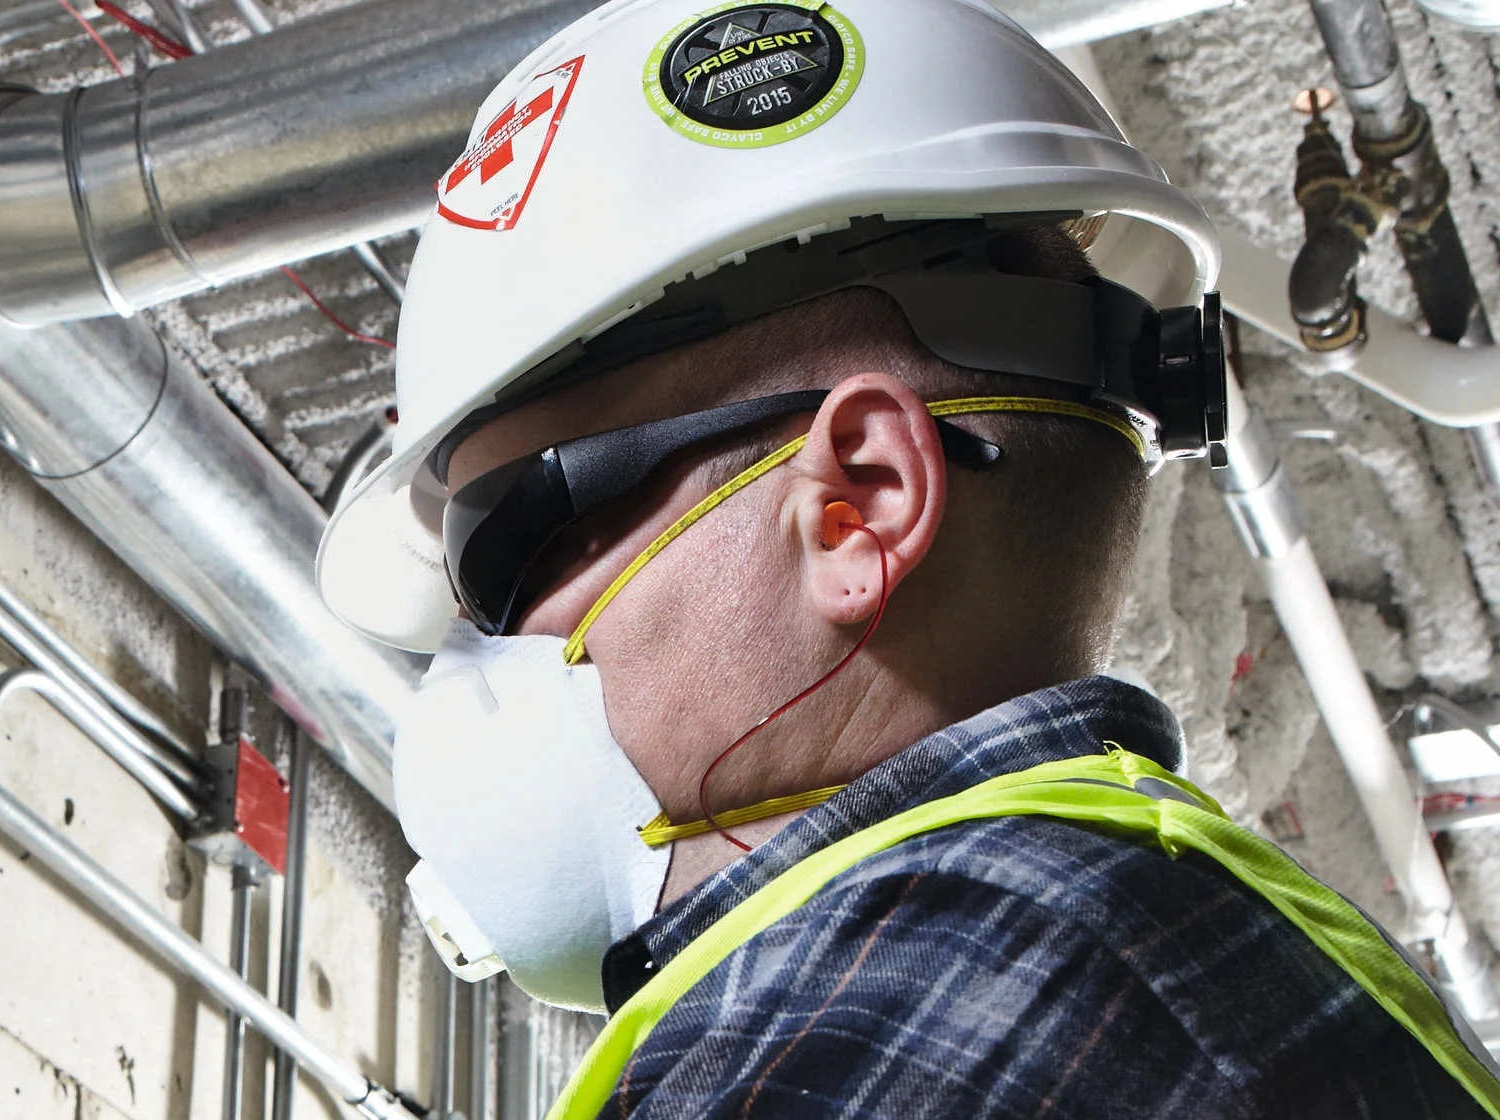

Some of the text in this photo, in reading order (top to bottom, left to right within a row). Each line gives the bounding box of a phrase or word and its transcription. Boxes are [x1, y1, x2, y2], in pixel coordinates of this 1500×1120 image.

[827, 15, 854, 45] CLAYCO
[684, 31, 814, 86] PREVENT
[719, 51, 790, 79] FALLING OBJECTS
[846, 47, 856, 71] SAFE
[717, 56, 799, 95] STRUCK-BY
[747, 86, 792, 115] 2015
[815, 95, 838, 116] LIVE
[680, 120, 710, 137] SAFE
[801, 114, 815, 127] BY
[712, 132, 763, 142] CLAYCO
